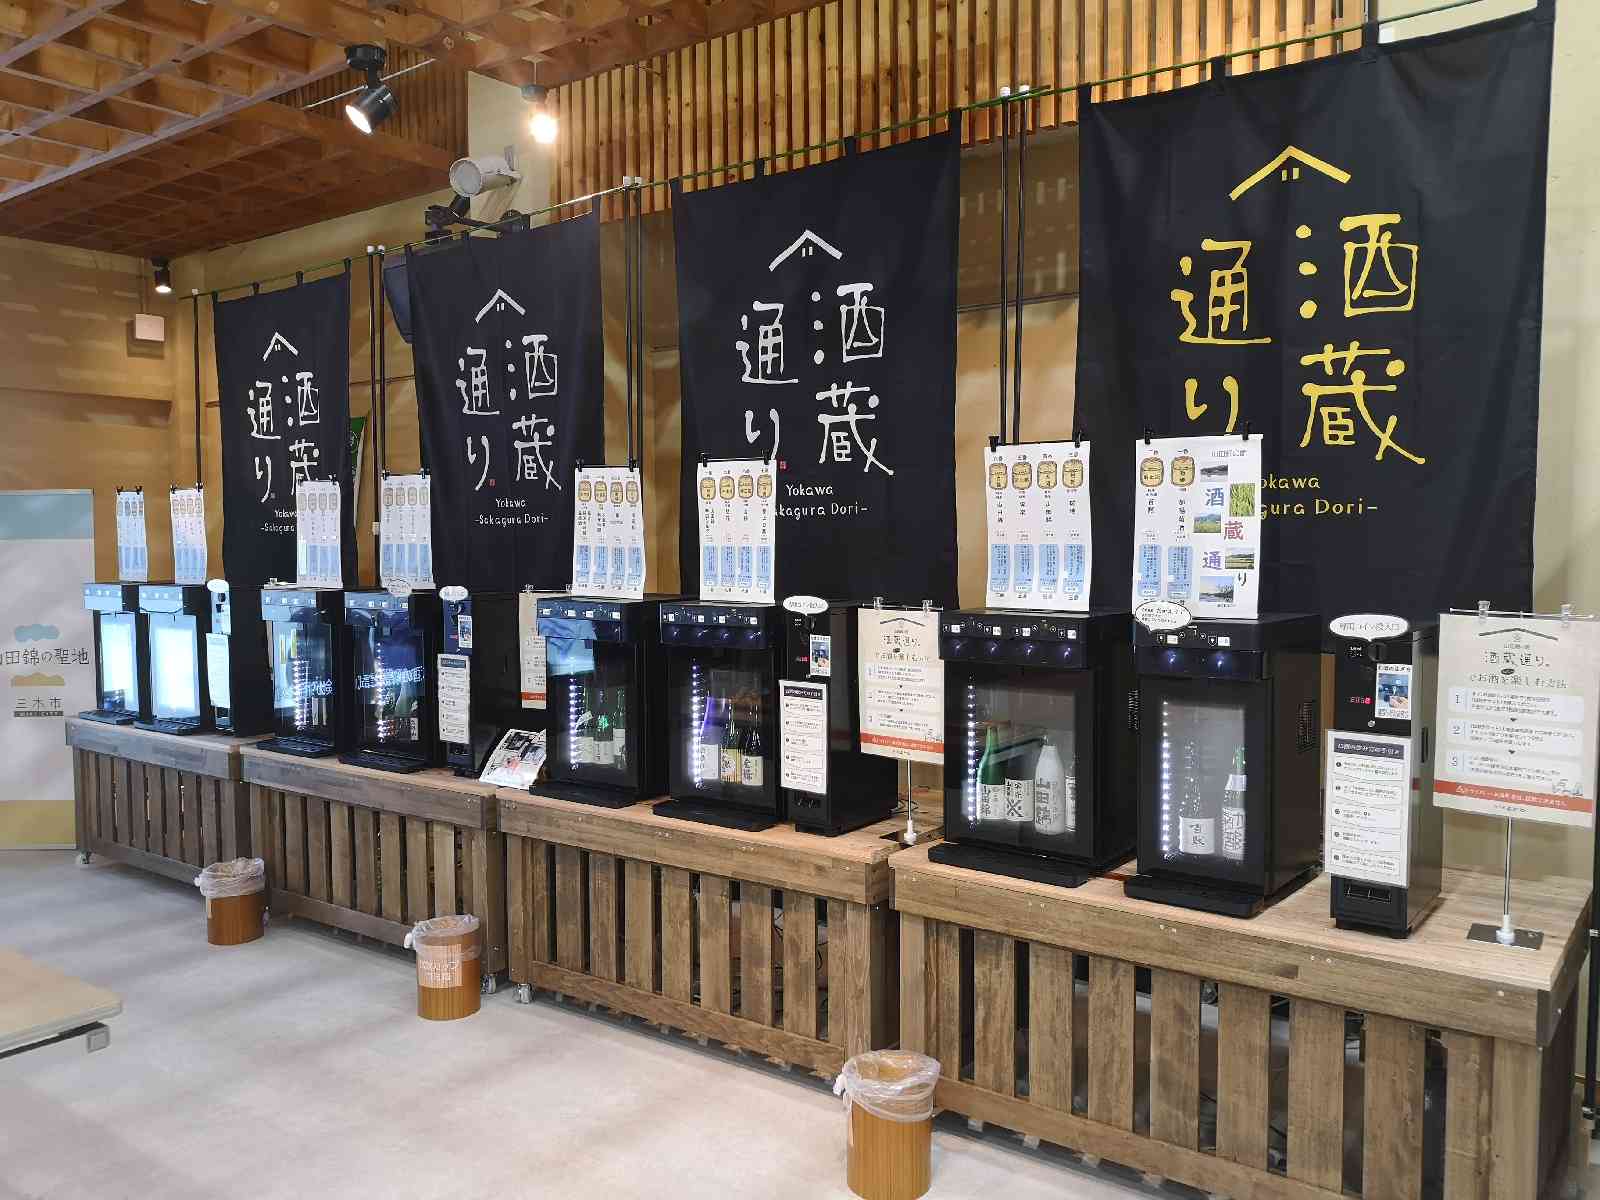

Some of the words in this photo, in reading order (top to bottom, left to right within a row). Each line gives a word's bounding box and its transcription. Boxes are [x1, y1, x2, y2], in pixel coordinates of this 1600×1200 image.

[736, 300, 799, 460] 通り
[812, 282, 894, 476] 酒蔵
[1170, 238, 1271, 435] 通り
[1296, 213, 1426, 465] 酒蔵
[247, 380, 281, 502] 通り
[455, 347, 501, 491] 通り
[505, 334, 561, 490] 酒蔵
[495, 497, 526, 508] Yokawa
[776, 504, 826, 521] kagura
[786, 483, 834, 497] Yokawa
[1261, 474, 1321, 489] okawa
[1314, 498, 1378, 515] Dori-
